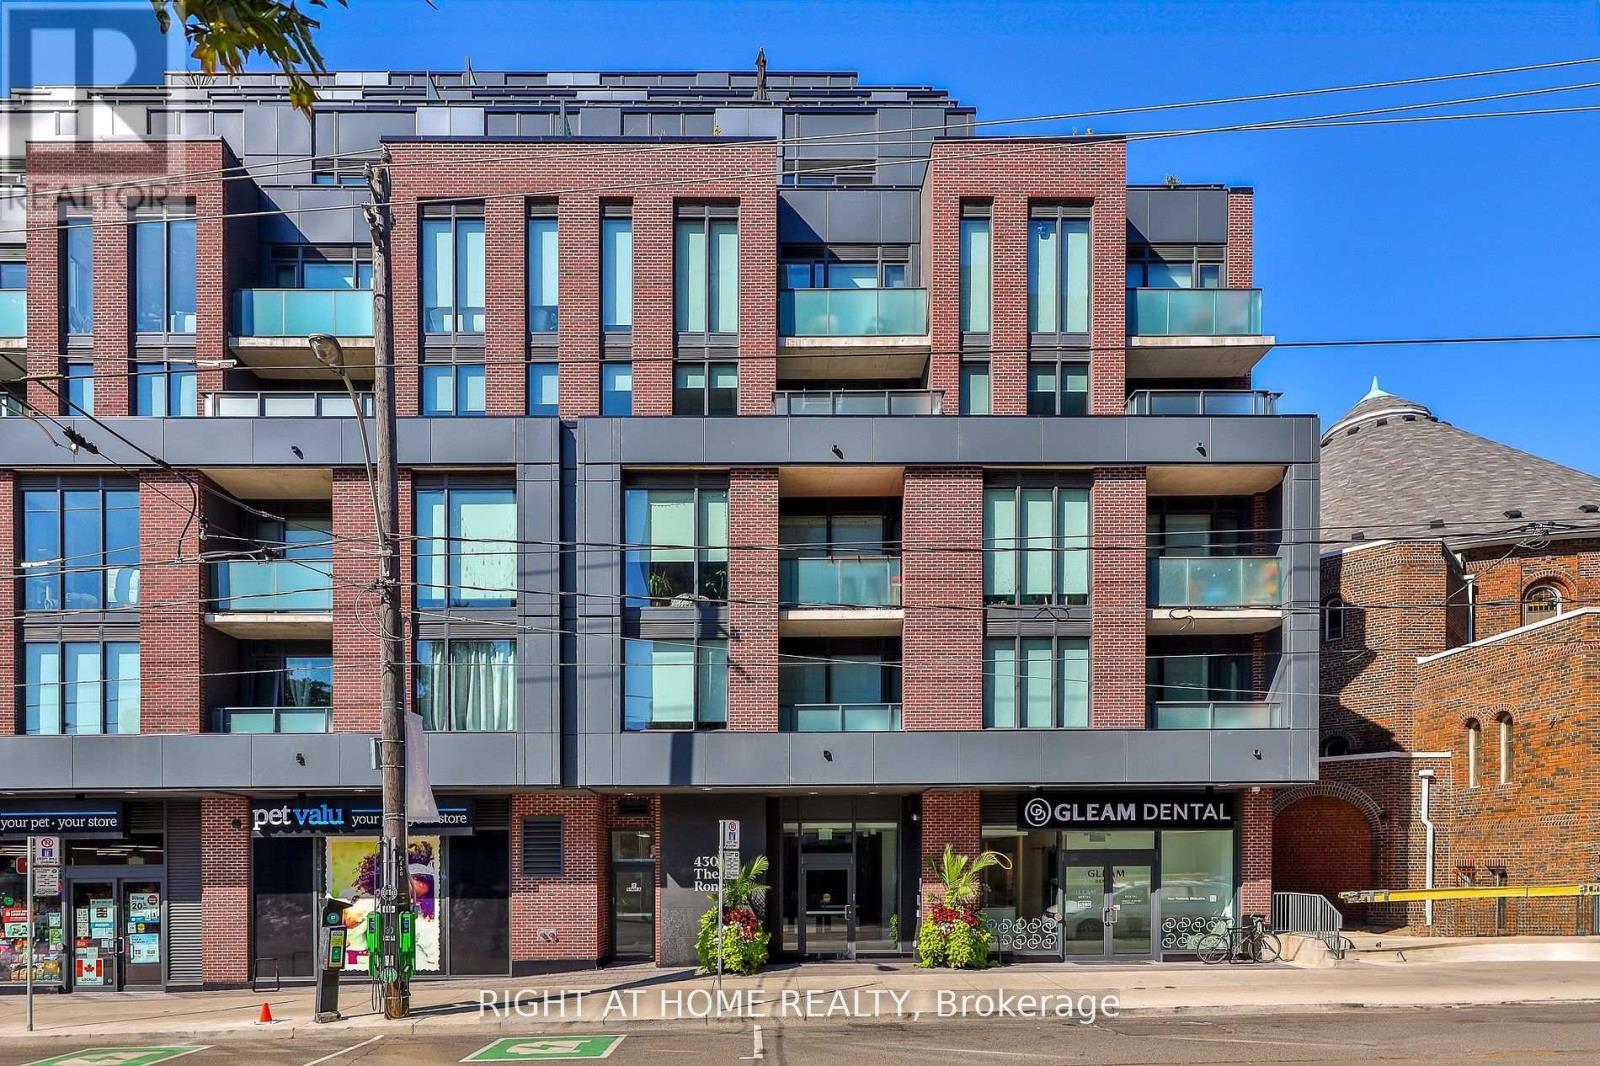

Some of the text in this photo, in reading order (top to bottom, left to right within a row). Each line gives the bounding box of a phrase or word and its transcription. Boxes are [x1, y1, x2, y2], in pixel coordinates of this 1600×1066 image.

[252, 804, 344, 831] pet valu
[352, 815, 379, 827] your
[439, 813, 467, 824] store
[1054, 803, 1231, 822] GLEAM DENTAL
[0, 816, 118, 831] your pet your store
[693, 868, 720, 880] The
